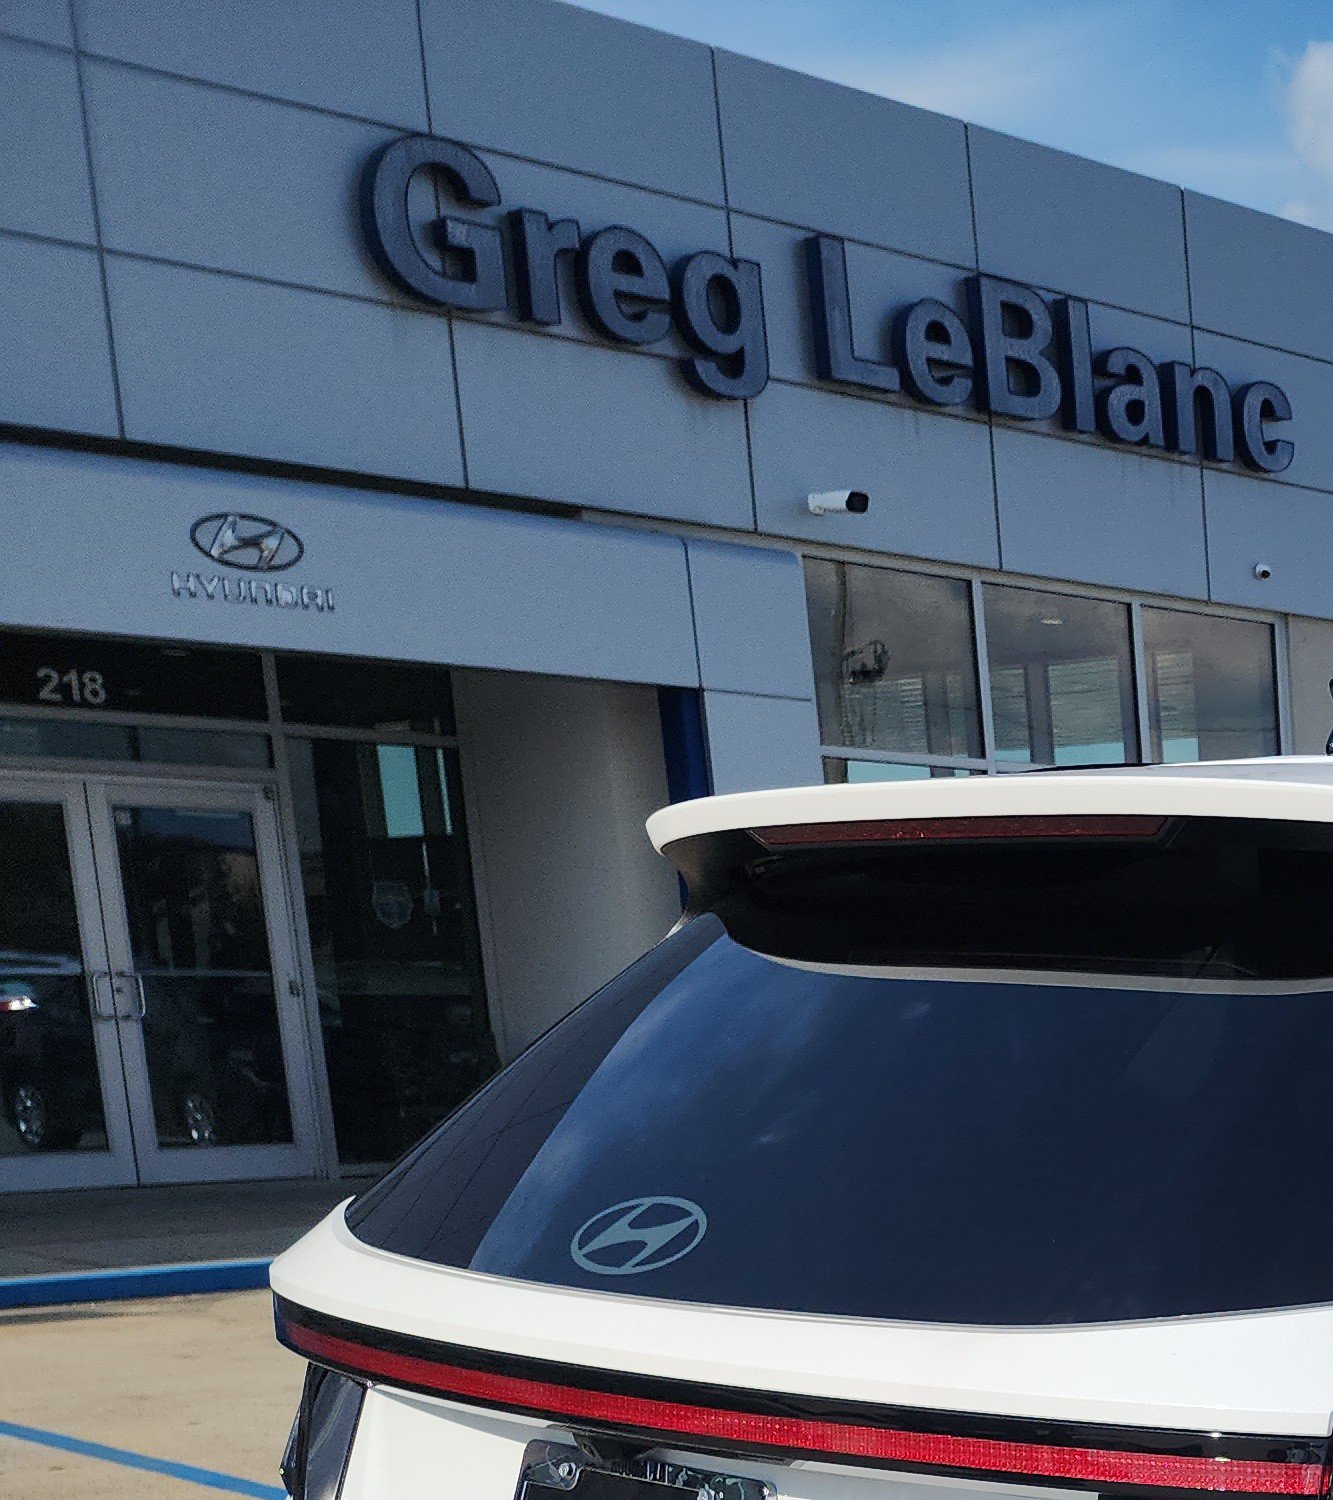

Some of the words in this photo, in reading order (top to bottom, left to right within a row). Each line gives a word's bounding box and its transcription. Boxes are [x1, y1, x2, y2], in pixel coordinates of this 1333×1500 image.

[358, 134, 770, 400] Greg
[803, 232, 1295, 474] LeBlanc
[170, 571, 337, 613] HYUNDAI
[35, 666, 108, 705] 218
